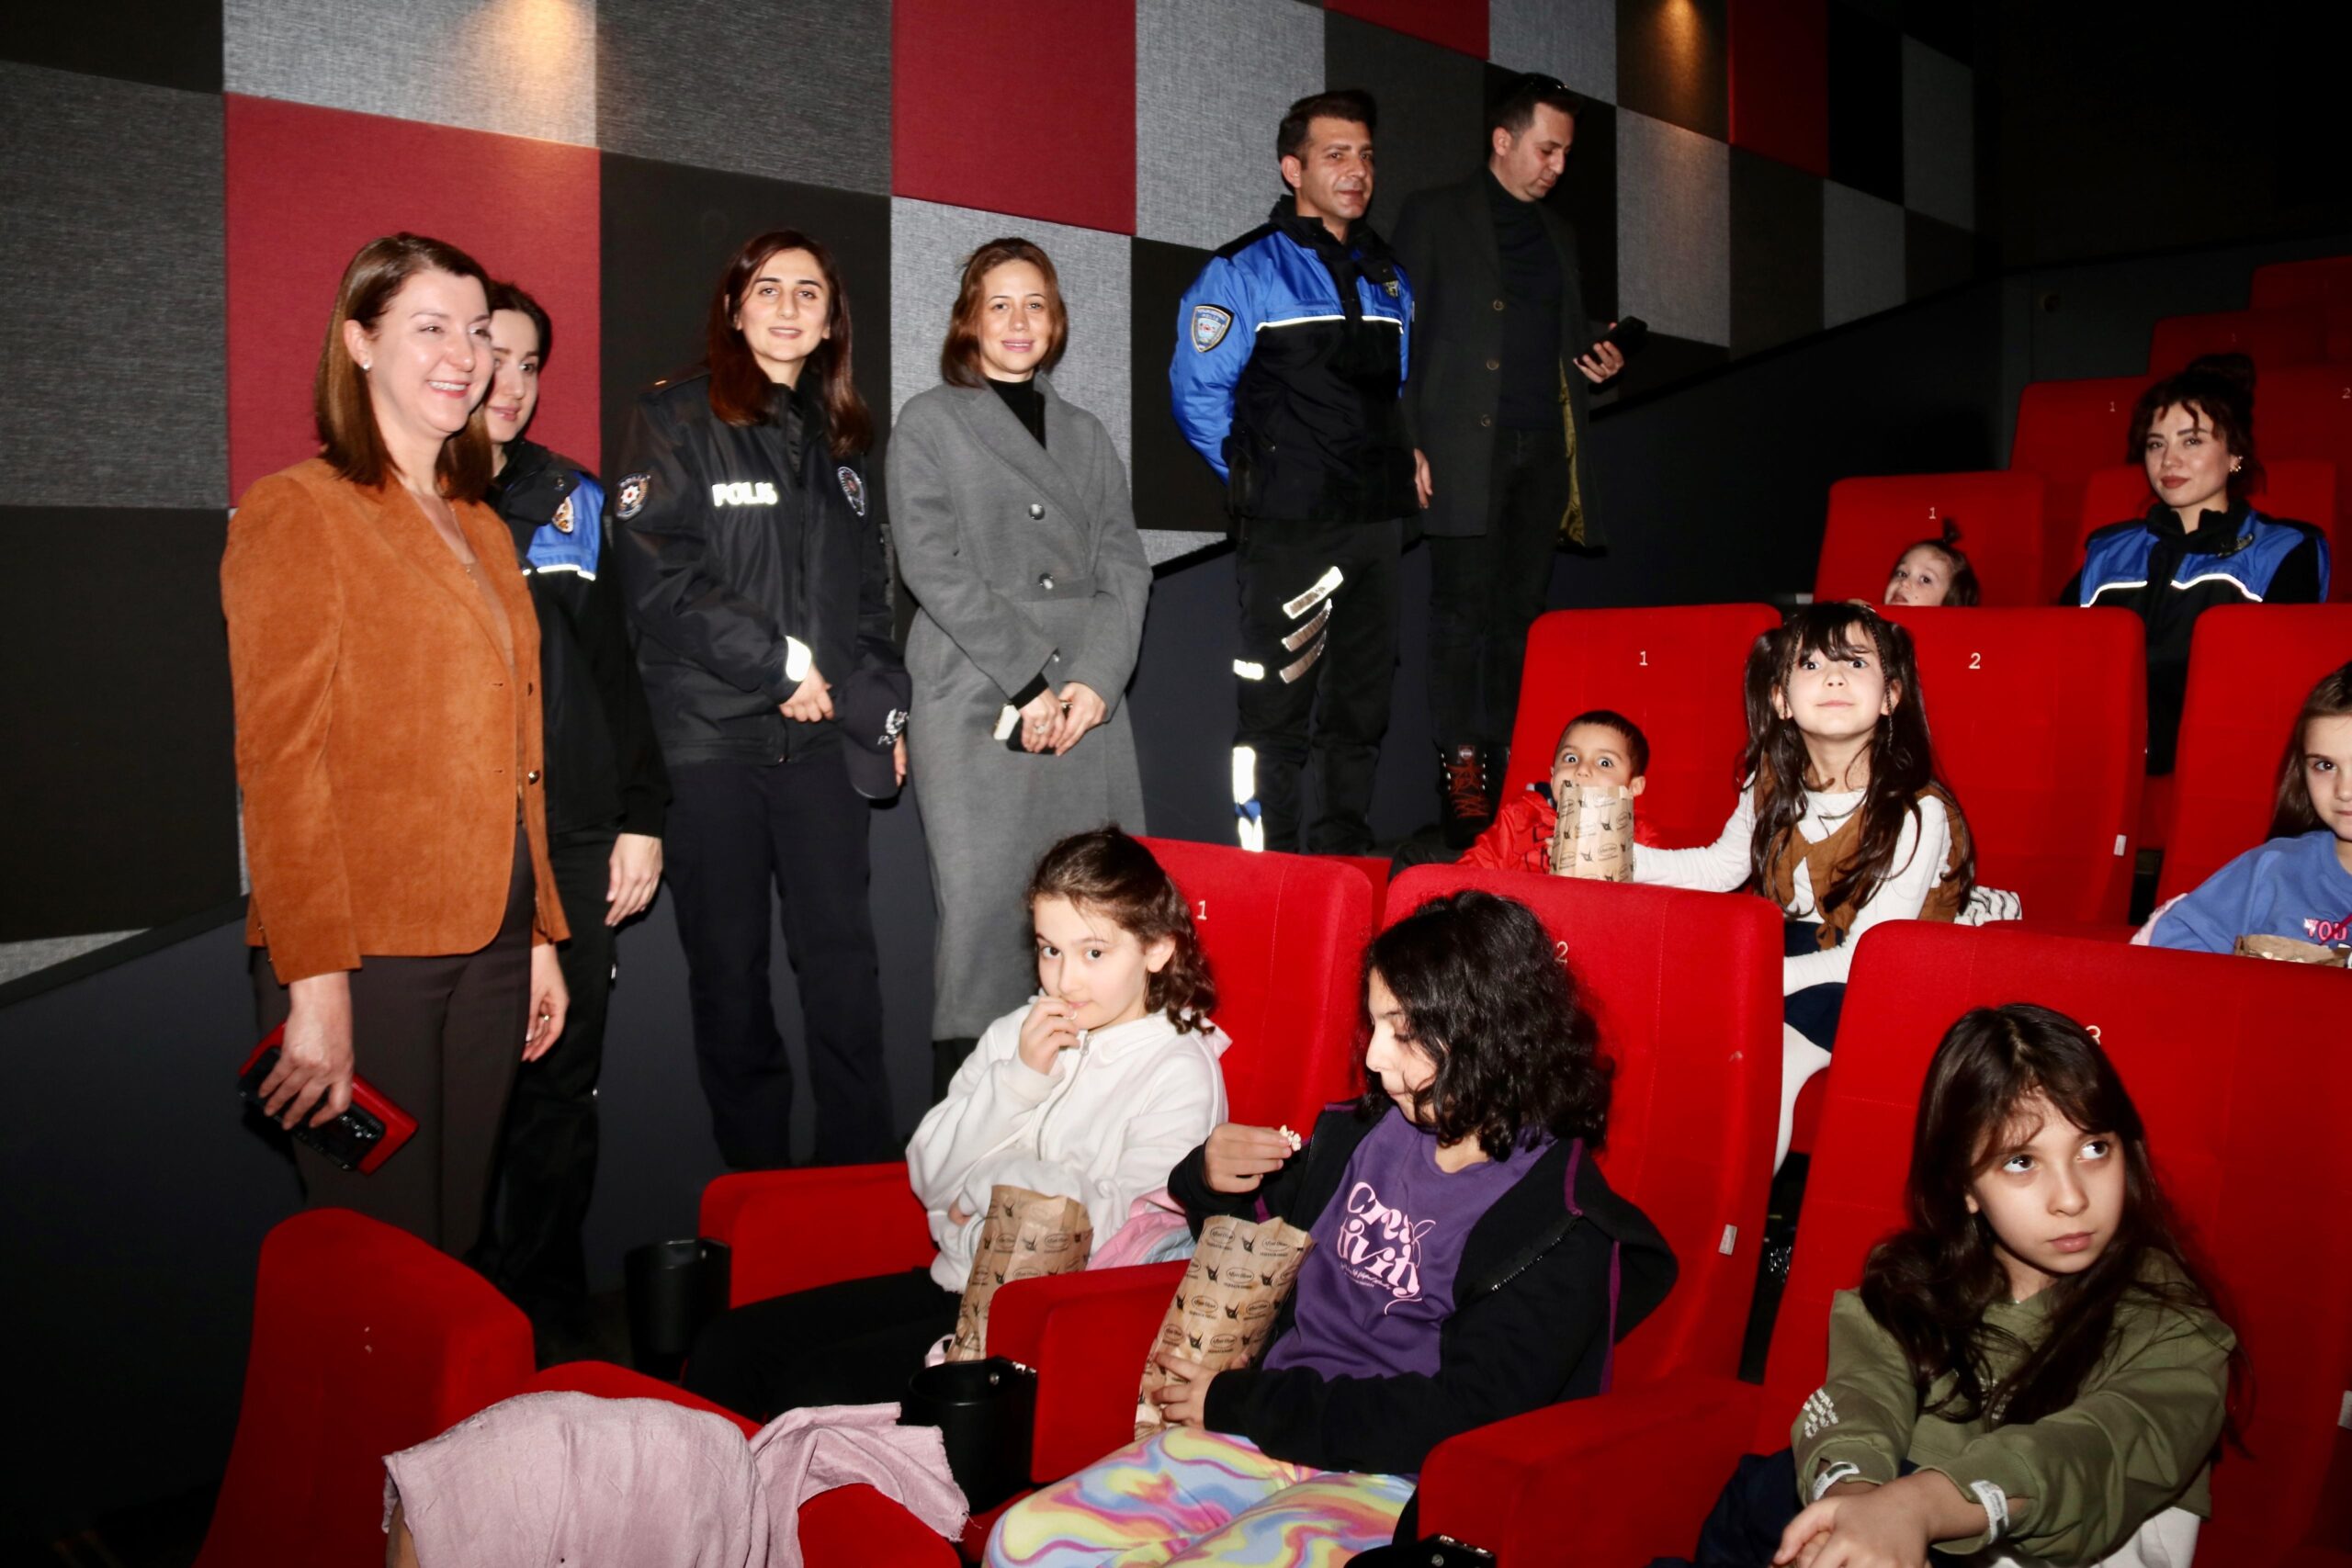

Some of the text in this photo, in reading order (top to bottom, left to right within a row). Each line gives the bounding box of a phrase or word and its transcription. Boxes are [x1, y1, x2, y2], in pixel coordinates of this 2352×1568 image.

[2342, 387, 2351, 400] 2
[2109, 401, 2116, 412] 1
[1928, 506, 1937, 520] 1
[1639, 650, 1648, 666] 1
[1968, 652, 1981, 670] 2
[1197, 900, 1207, 920] 1
[1555, 941, 1569, 964] 2
